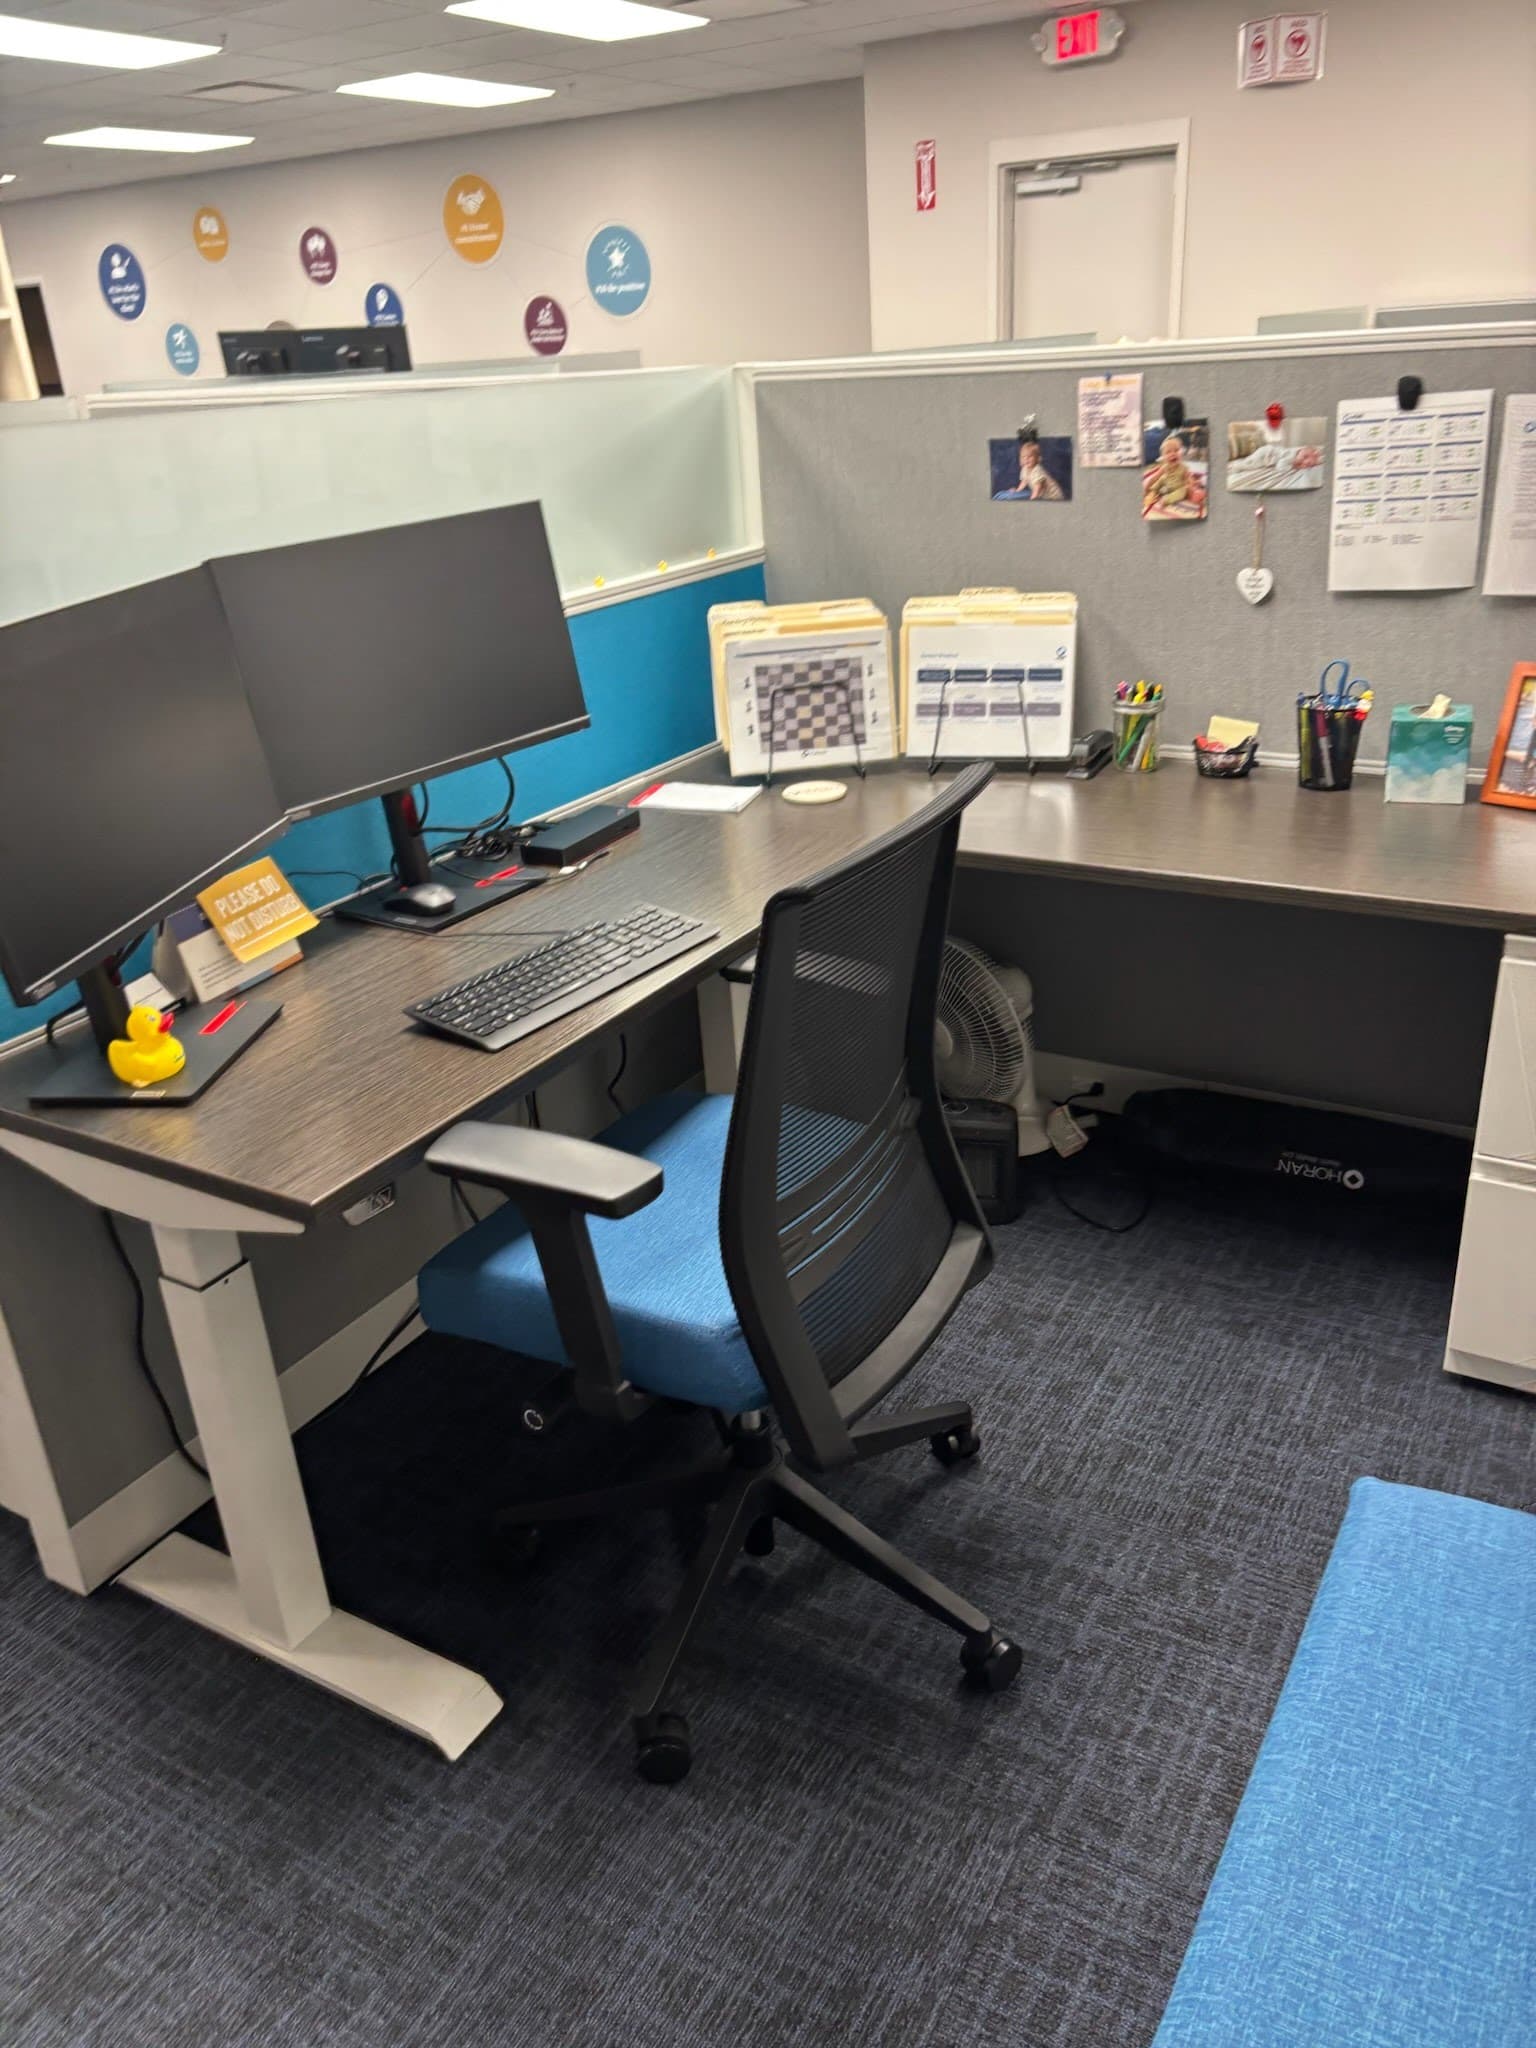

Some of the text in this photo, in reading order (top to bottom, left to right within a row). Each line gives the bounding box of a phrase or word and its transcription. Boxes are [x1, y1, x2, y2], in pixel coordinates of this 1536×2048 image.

[1058, 11, 1100, 60] EXIT
[214, 875, 281, 918] PLEASE DO
[224, 894, 301, 944] NOT DISTURB
[1277, 1158, 1342, 1183] HORAN
